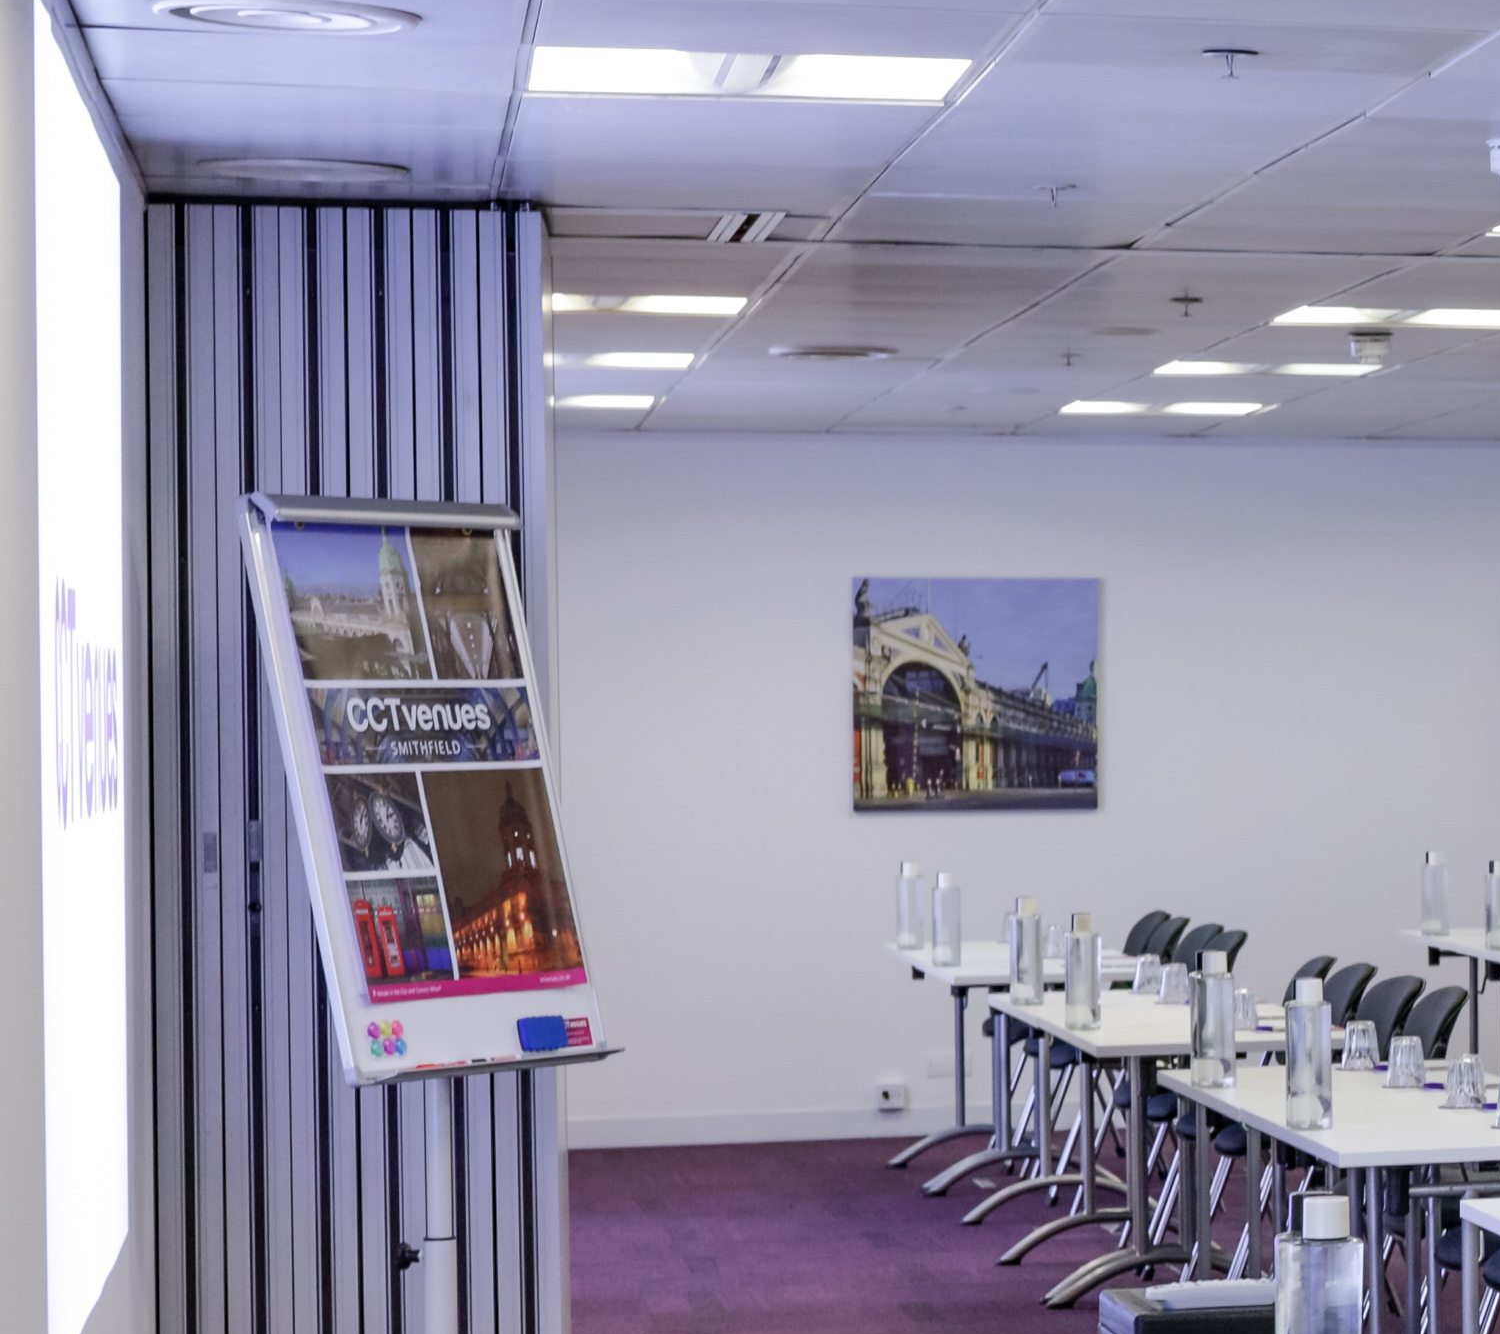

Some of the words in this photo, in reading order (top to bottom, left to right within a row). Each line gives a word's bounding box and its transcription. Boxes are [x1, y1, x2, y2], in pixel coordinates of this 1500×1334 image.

[55, 572, 118, 832] CCTvenues
[346, 697, 491, 732] CCTvenues
[391, 740, 461, 756] SMITHFIELD
